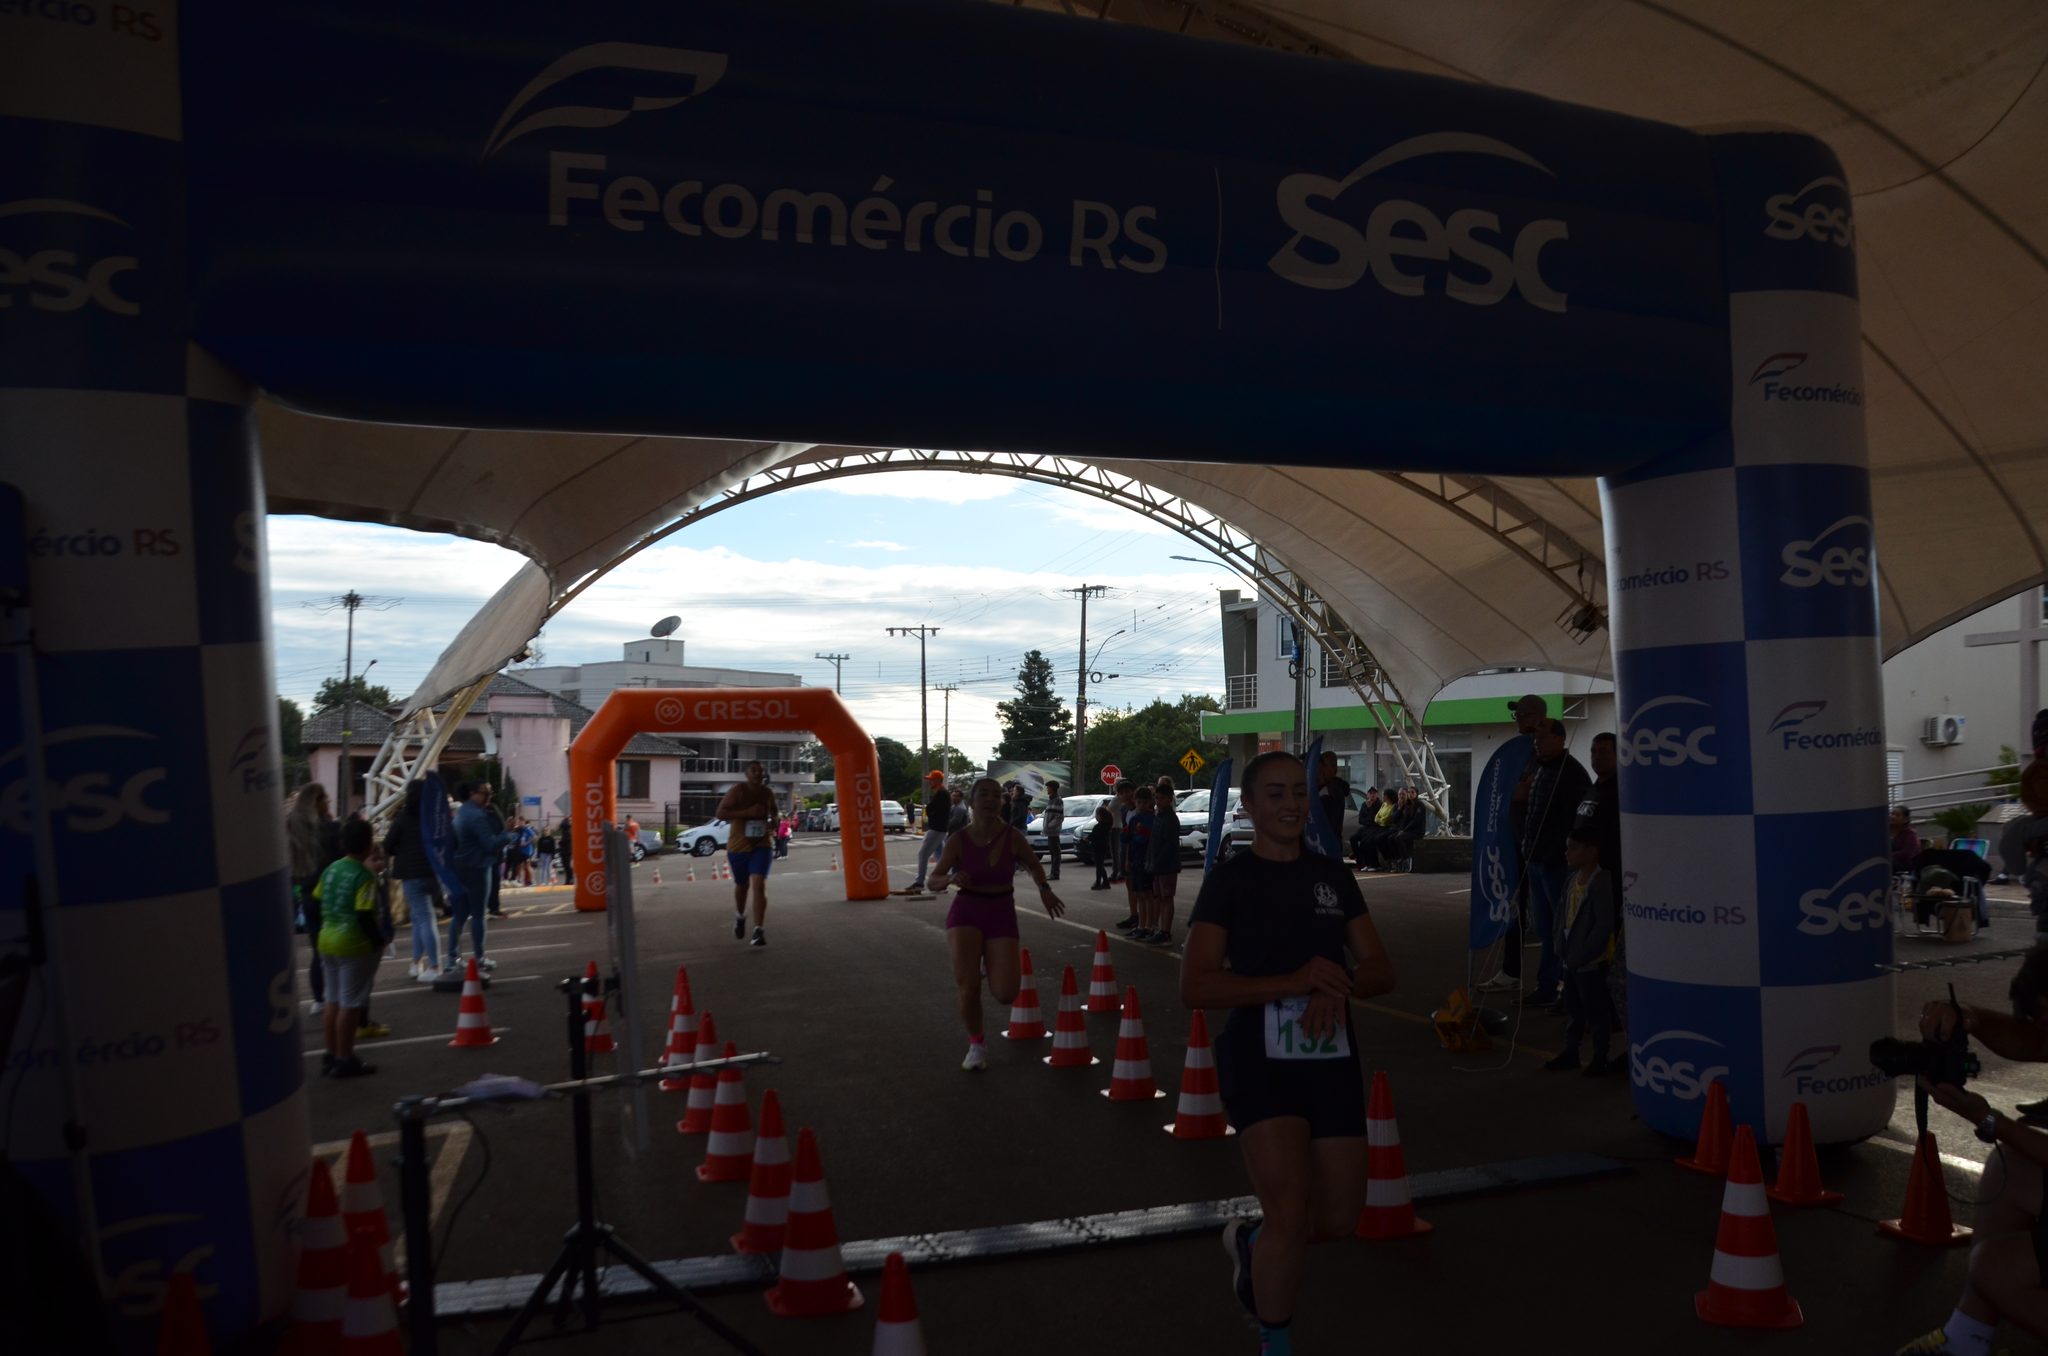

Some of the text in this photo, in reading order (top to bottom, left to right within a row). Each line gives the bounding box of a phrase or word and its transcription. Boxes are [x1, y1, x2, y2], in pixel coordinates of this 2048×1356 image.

[111, 4, 162, 42] RS
[547, 150, 1169, 274] Fecomércio RS
[1266, 172, 1570, 314] Sesc
[133, 528, 180, 557] RS
[1696, 560, 1729, 582] RS
[693, 698, 800, 721] CRESOL
[585, 774, 606, 865] CRESOL
[855, 764, 877, 852] CRESOL
[1713, 905, 1747, 925] RS
